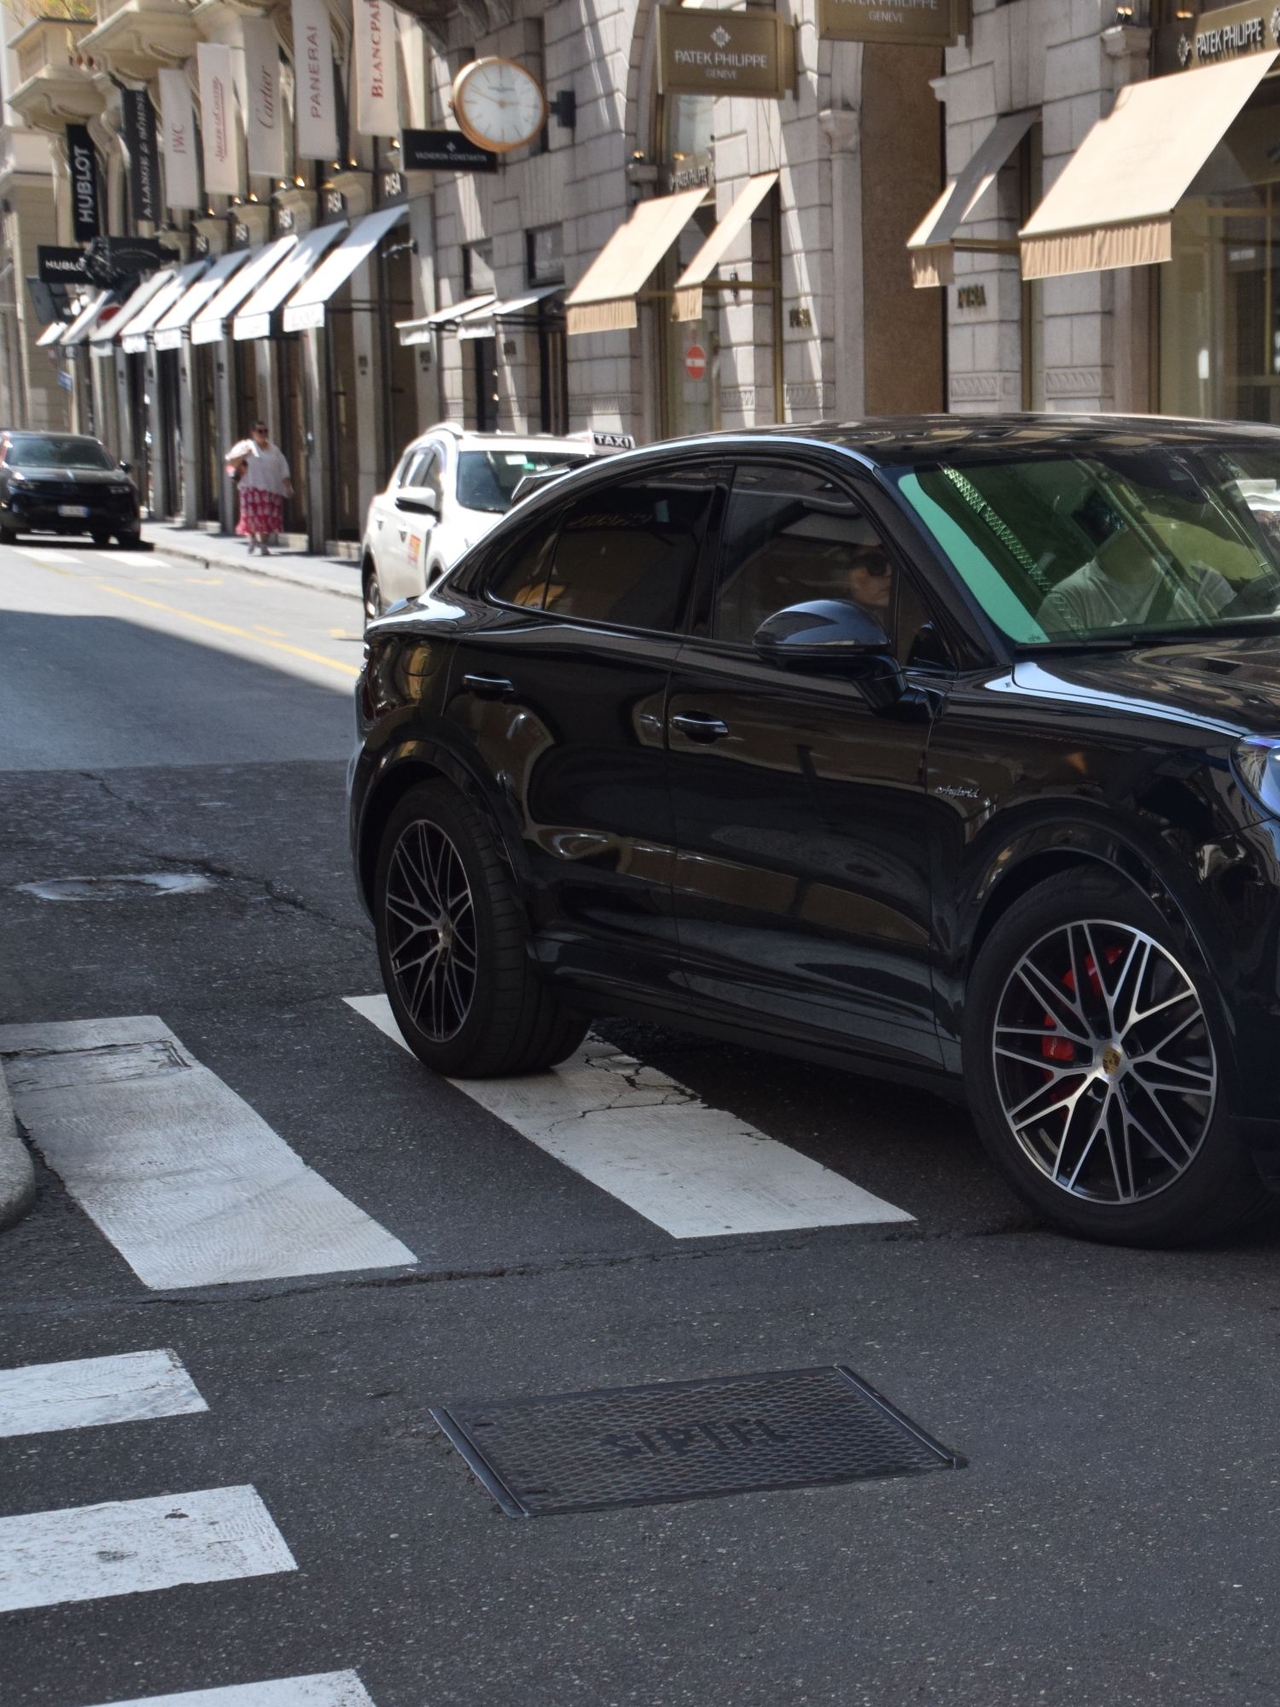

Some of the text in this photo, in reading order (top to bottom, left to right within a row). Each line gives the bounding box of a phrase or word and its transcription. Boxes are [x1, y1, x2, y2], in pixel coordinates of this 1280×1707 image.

[1195, 17, 1263, 56] PATEK PHILIPPE
[306, 25, 322, 119] PANERAI
[675, 49, 768, 69] PATEK PHILIPPE
[705, 68, 738, 80] GENEVE
[255, 64, 274, 130] Cartier
[171, 122, 187, 155] IWC
[73, 145, 95, 224] HUBLOT
[593, 434, 631, 449] TAXI
